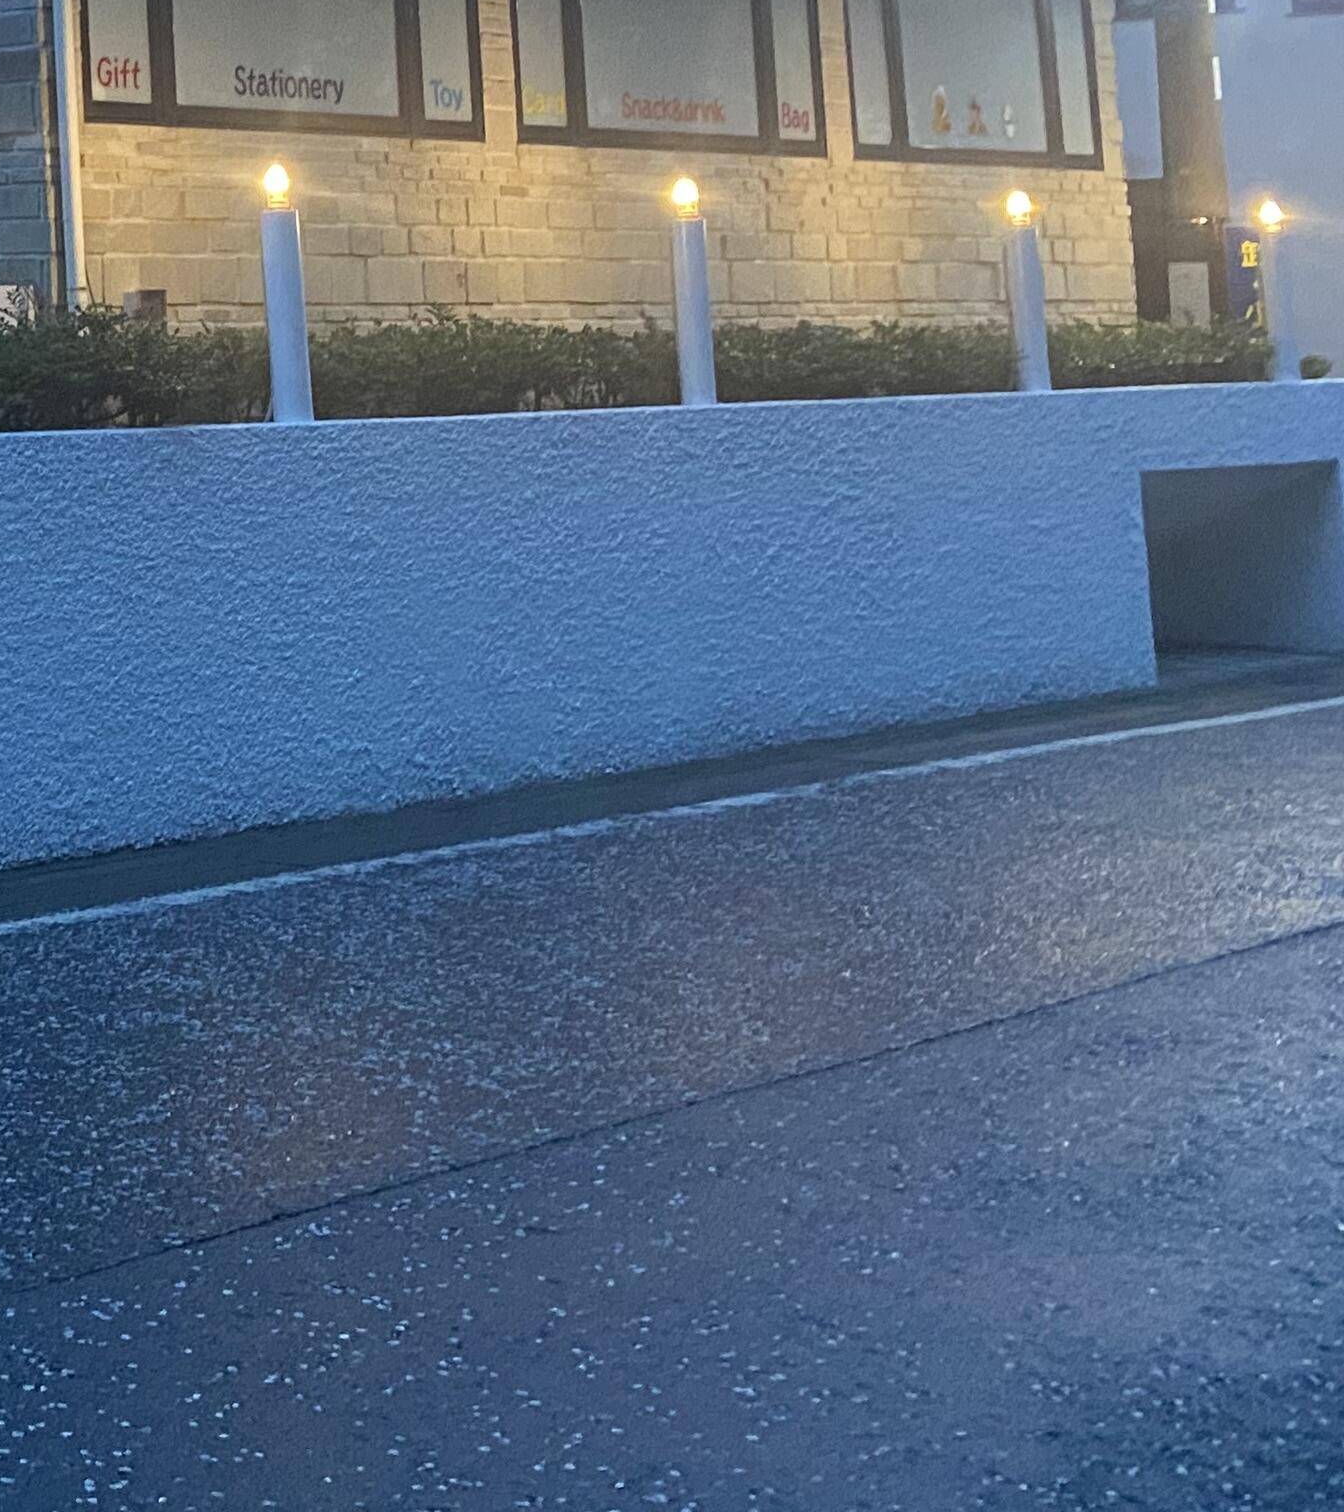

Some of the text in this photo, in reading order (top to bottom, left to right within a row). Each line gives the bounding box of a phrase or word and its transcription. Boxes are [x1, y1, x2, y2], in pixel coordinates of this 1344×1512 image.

[96, 56, 141, 90] Gift
[234, 65, 344, 104] Stationery
[429, 79, 463, 112] Toy
[780, 102, 810, 134] Bag
